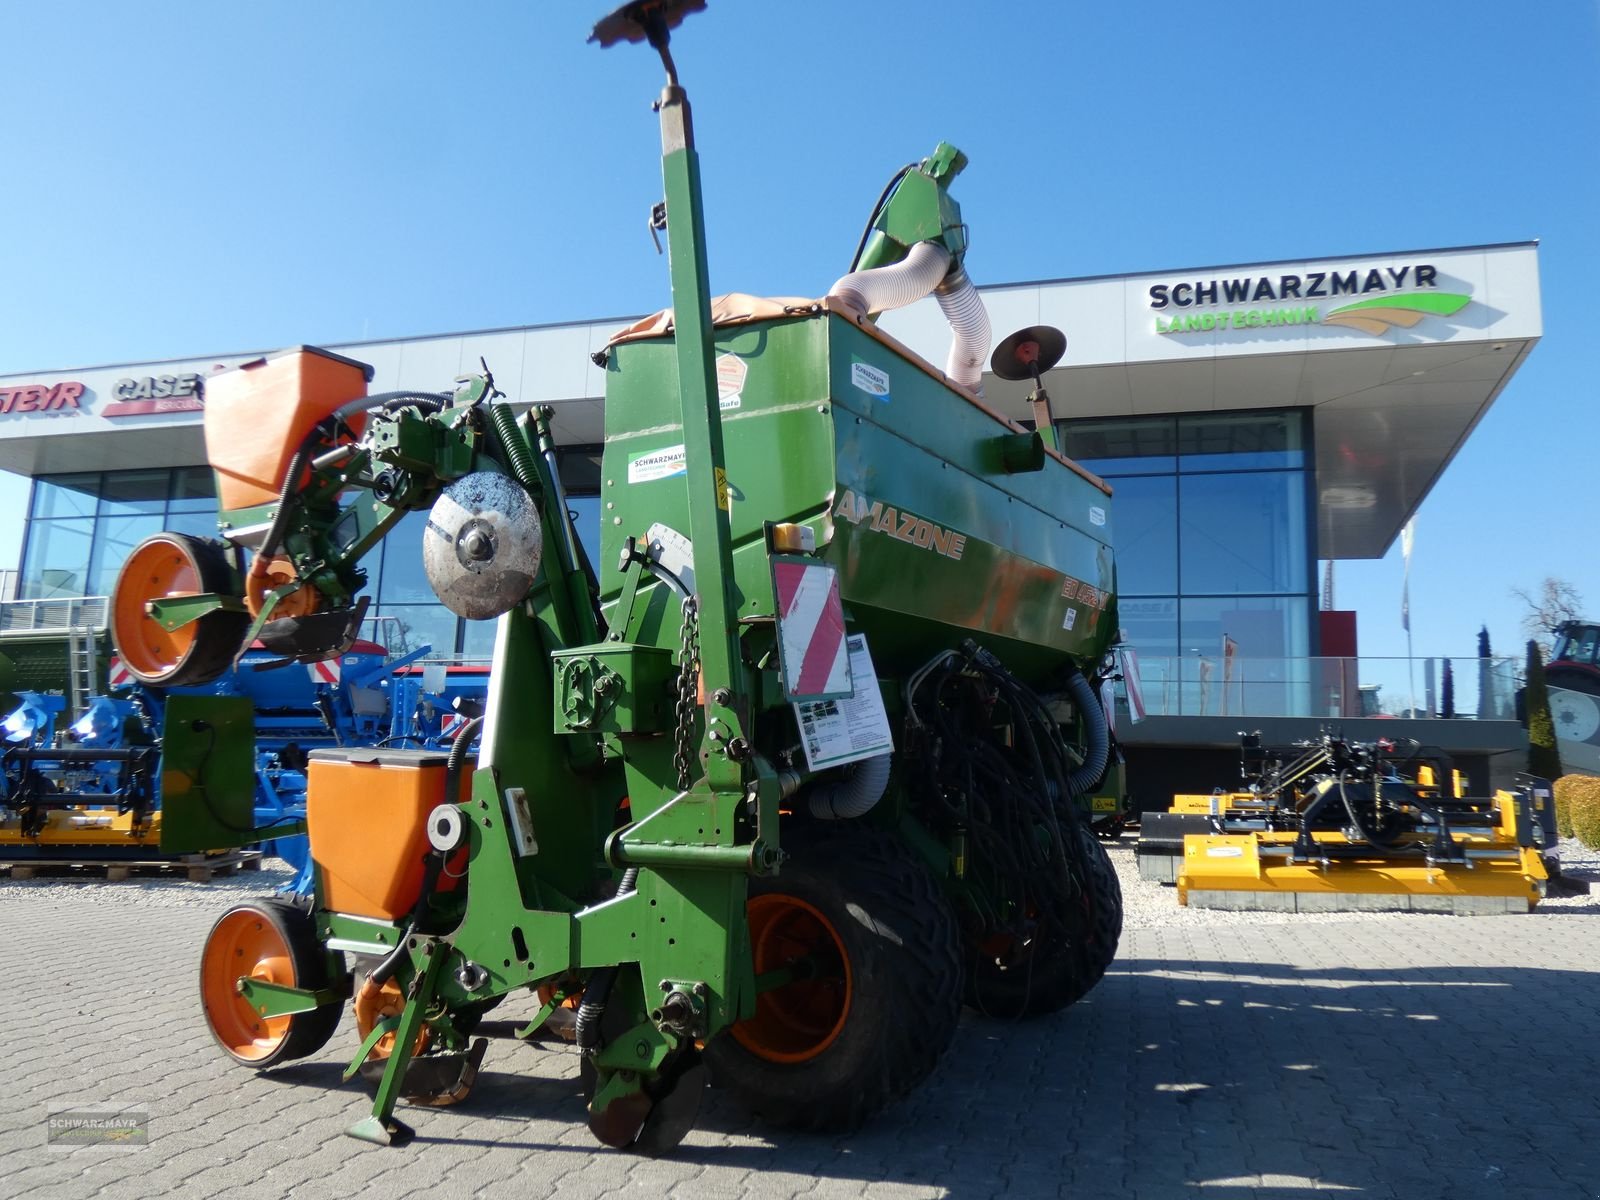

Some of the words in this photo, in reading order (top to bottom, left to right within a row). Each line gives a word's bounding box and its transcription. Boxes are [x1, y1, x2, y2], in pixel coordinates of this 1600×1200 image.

[1149, 264, 1437, 309] SCHWARZMAYR
[1155, 306, 1320, 333] LANDTECHNIK
[0, 381, 85, 414] TEYR
[112, 374, 199, 401] CASE
[833, 489, 967, 560] AMAZONE
